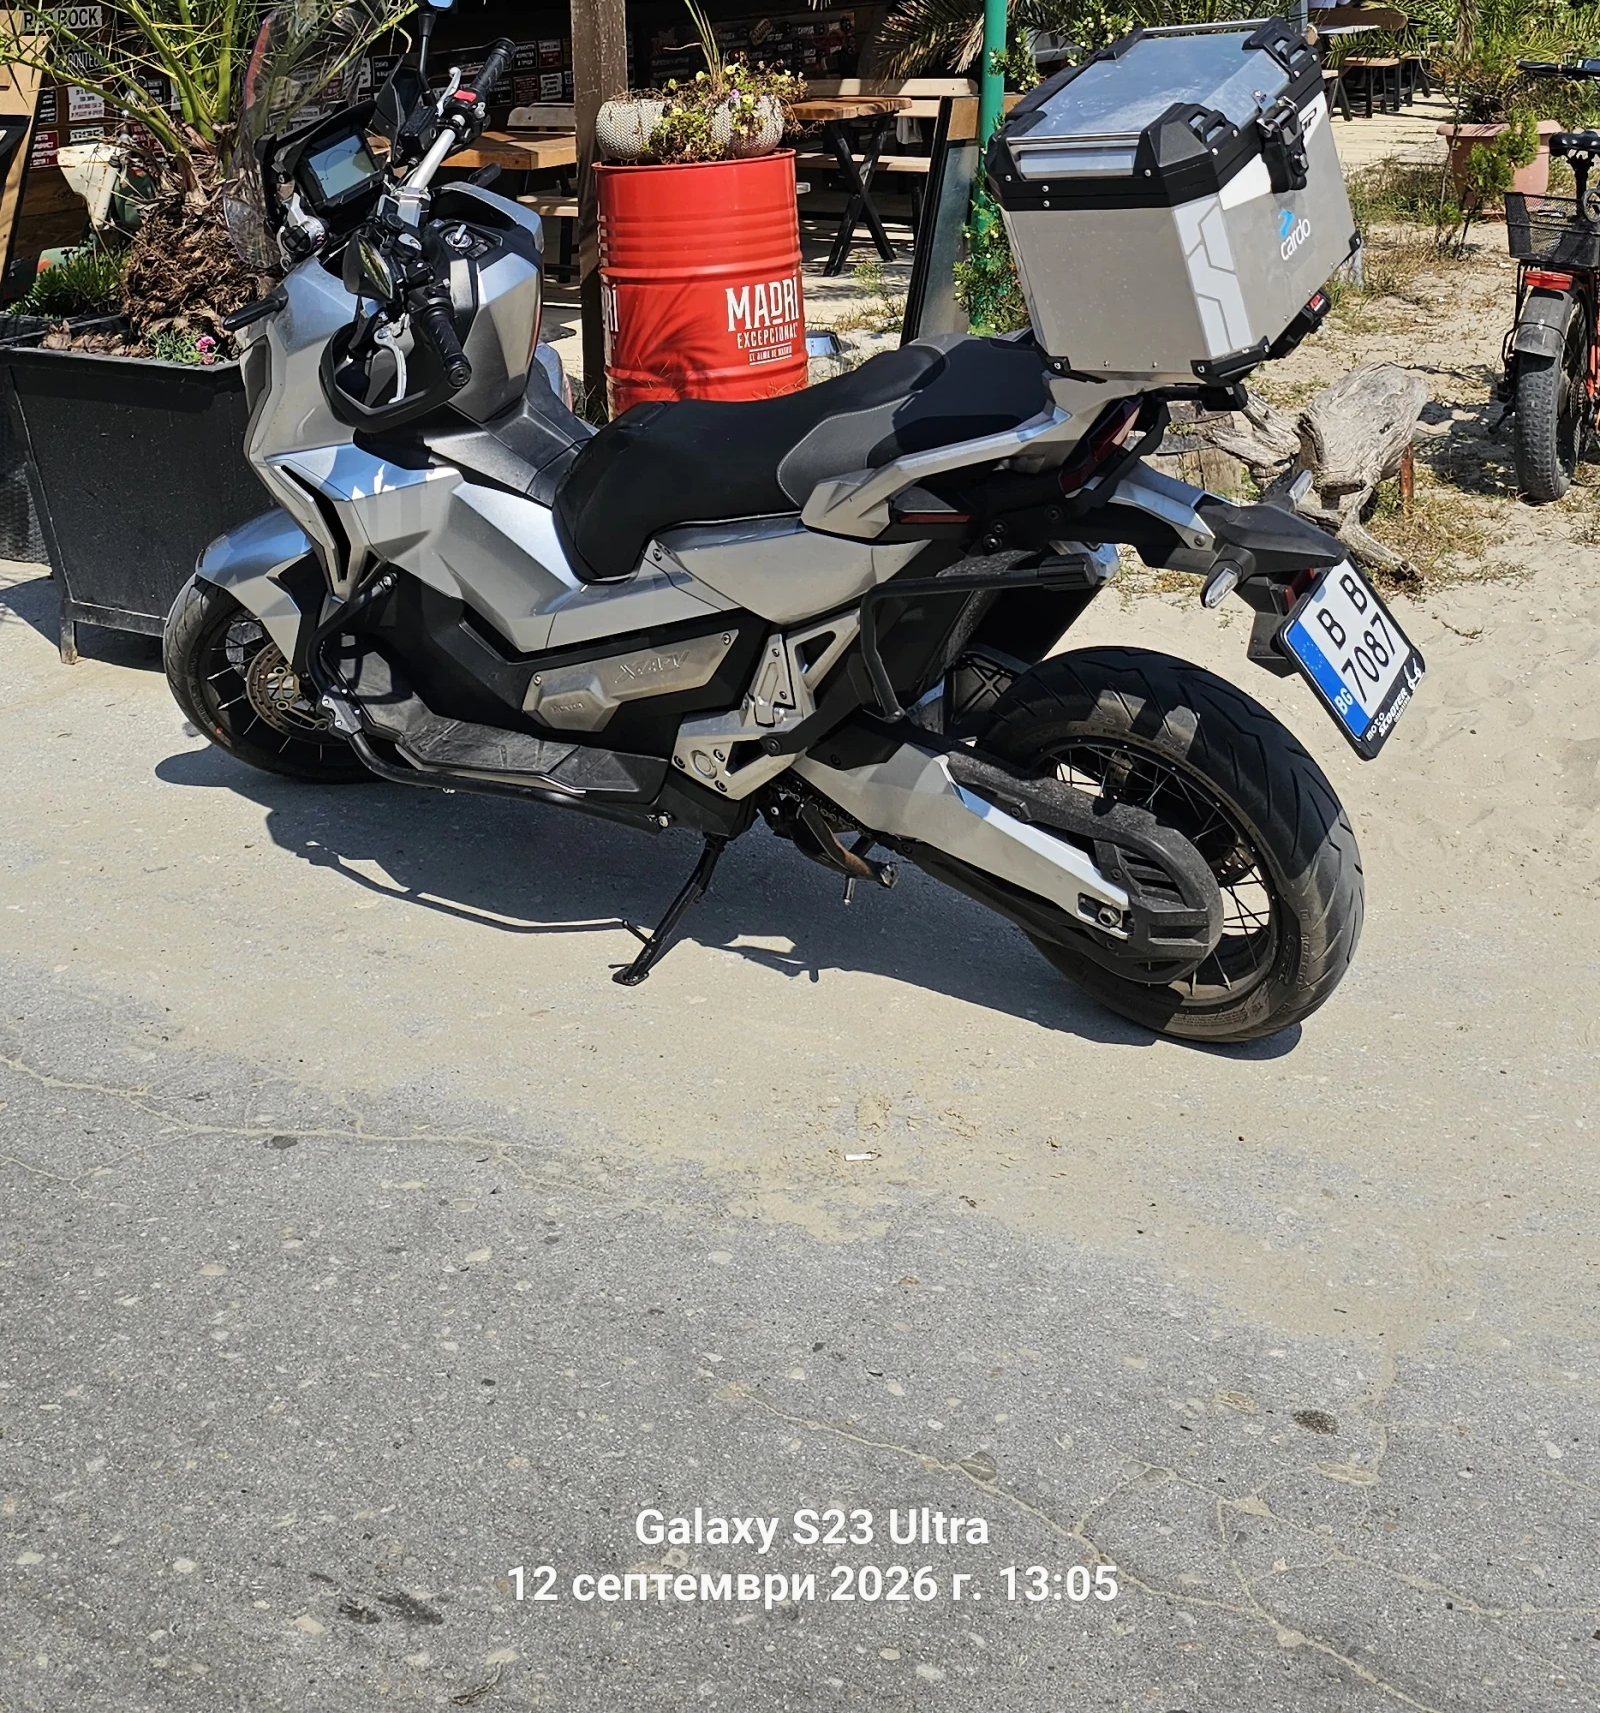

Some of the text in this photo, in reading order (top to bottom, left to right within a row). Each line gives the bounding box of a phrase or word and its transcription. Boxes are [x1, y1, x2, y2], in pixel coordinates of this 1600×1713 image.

[1280, 218, 1311, 261] cardo
[725, 270, 800, 333] MADRÍ
[737, 322, 798, 349] EXCEPCIONAL
[1341, 612, 1396, 704] 7087
[1334, 687, 1353, 716] BG
[1378, 687, 1408, 737] SCOOTER
